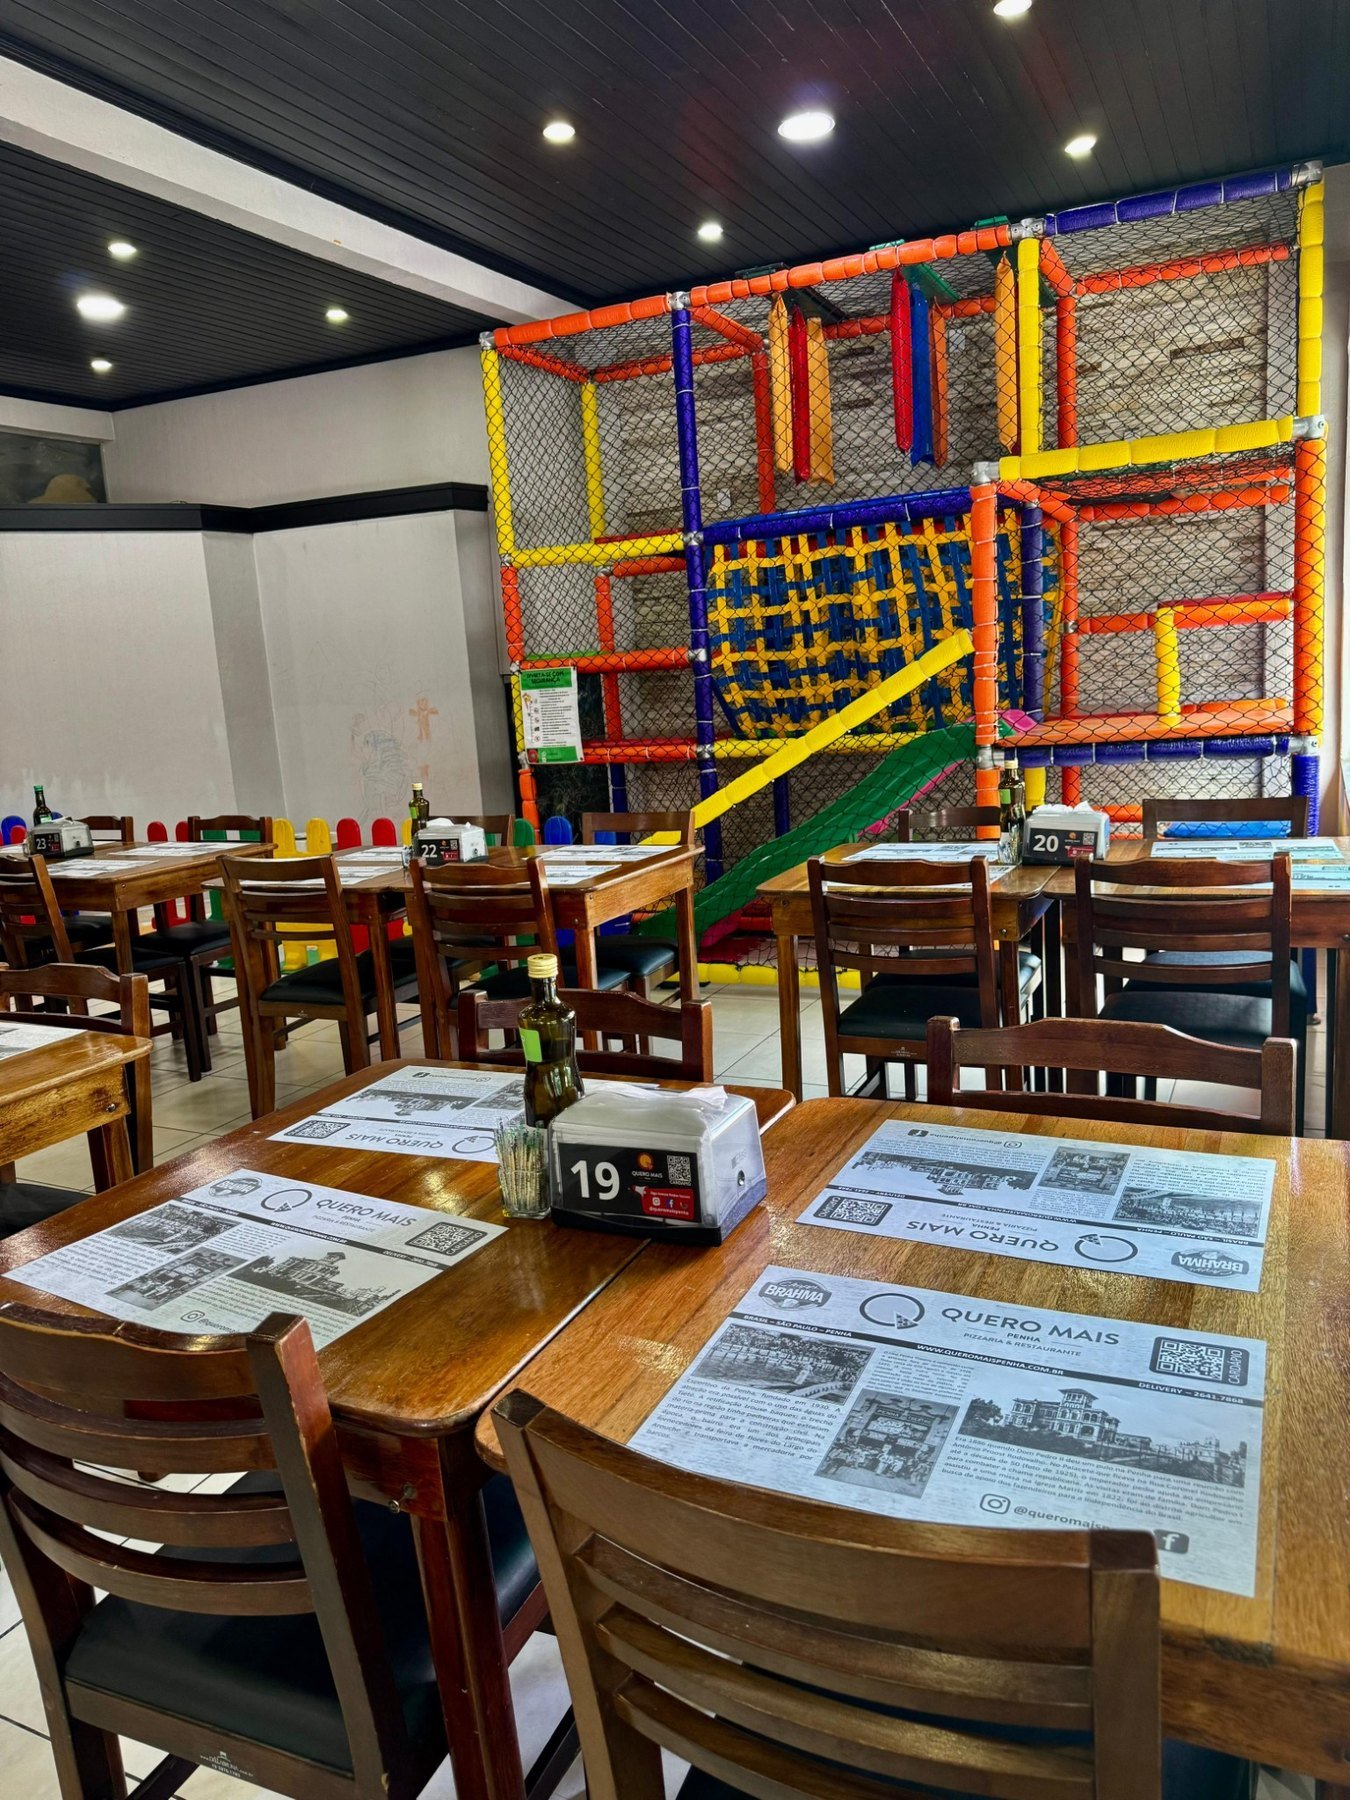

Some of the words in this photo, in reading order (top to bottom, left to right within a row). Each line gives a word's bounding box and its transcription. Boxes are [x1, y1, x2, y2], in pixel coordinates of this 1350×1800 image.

[35, 838, 47, 850] 23
[421, 844, 438, 858] 22
[1033, 834, 1059, 853] 20
[570, 1160, 620, 1201] 19
[316, 1199, 374, 1216] QUERO
[372, 1211, 417, 1227] MAIS
[906, 1220, 965, 1237] MAIS
[972, 1223, 1000, 1232] PENHA
[969, 1230, 1059, 1251] QUERO
[1178, 1255, 1243, 1273] BRAHMA
[764, 1284, 824, 1304] BRAHMA
[743, 1313, 769, 1324] BRASIL
[775, 1319, 792, 1329] SÃO
[791, 1322, 818, 1332] PAULO
[825, 1328, 852, 1338] PENHA
[941, 1307, 1042, 1333] QUERO
[1048, 1324, 1120, 1346] MAIS
[963, 1332, 1004, 1345] PIZZARIA
[1014, 1341, 1082, 1357] RESTAURANTE
[1006, 1331, 1041, 1343] PENHA
[916, 1344, 1065, 1376] WWW.QUEROMAISPENHA.COM.BR
[1228, 1348, 1245, 1385] CARDÁPIO
[760, 1393, 791, 1402] fundado
[1138, 1381, 1183, 1395] DELIVERY
[702, 1403, 727, 1412] região
[745, 1412, 780, 1423] pedreiras
[718, 1414, 736, 1422] para
[748, 1420, 789, 1433] construção
[808, 1417, 833, 1425] trecho
[701, 1418, 724, 1426] bairro
[785, 1435, 822, 1447] principais
[716, 1428, 734, 1436] feira
[747, 1435, 769, 1443] flores
[782, 1442, 805, 1451] Largo
[692, 1432, 739, 1446] transportava
[752, 1444, 796, 1457] mercadoria
[970, 1452, 996, 1462] década
[1022, 1463, 1040, 1471] (foto
[1088, 1476, 1129, 1488] imperador
[986, 1443, 1015, 1452] quando
[1036, 1452, 1057, 1460] Pedro
[1127, 1469, 1151, 1478] Penha
[941, 1468, 962, 1476] busca
[1012, 1483, 1056, 1495] fazendeiros
[944, 1462, 971, 1470] assistiu
[998, 1473, 1019, 1481] missa
[1058, 1485, 1083, 1494] Matriz
[965, 1459, 999, 1469] combater
[1008, 1468, 1033, 1476] chama
[1095, 1485, 1119, 1493] visitas
[1062, 1464, 1094, 1475] Palacete
[1112, 1474, 1134, 1482] ficava
